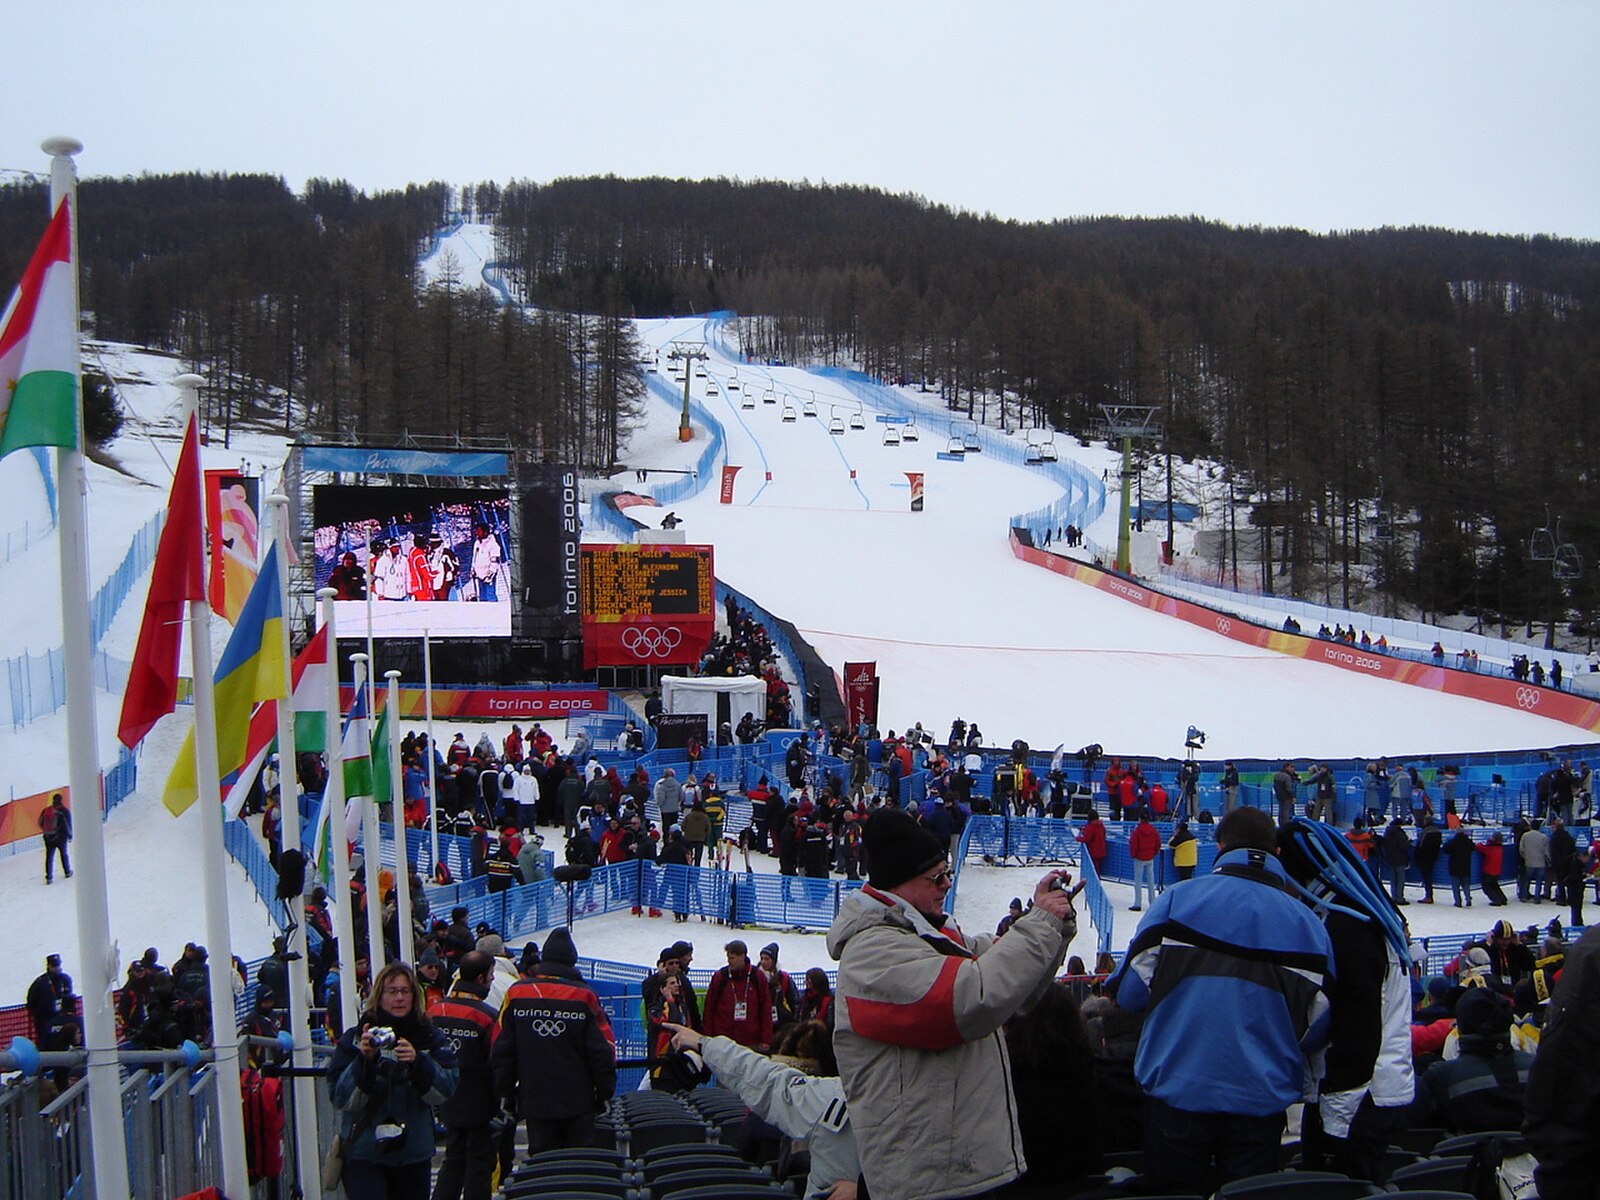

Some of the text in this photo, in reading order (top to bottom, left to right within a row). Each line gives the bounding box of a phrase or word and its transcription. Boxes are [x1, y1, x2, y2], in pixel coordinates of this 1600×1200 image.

[563, 472, 577, 615] torino 2006
[1324, 647, 1382, 670] torino 2006
[489, 698, 593, 710] torino 2006
[513, 1008, 586, 1020] torino 2006
[451, 1028, 479, 1038] 2006
